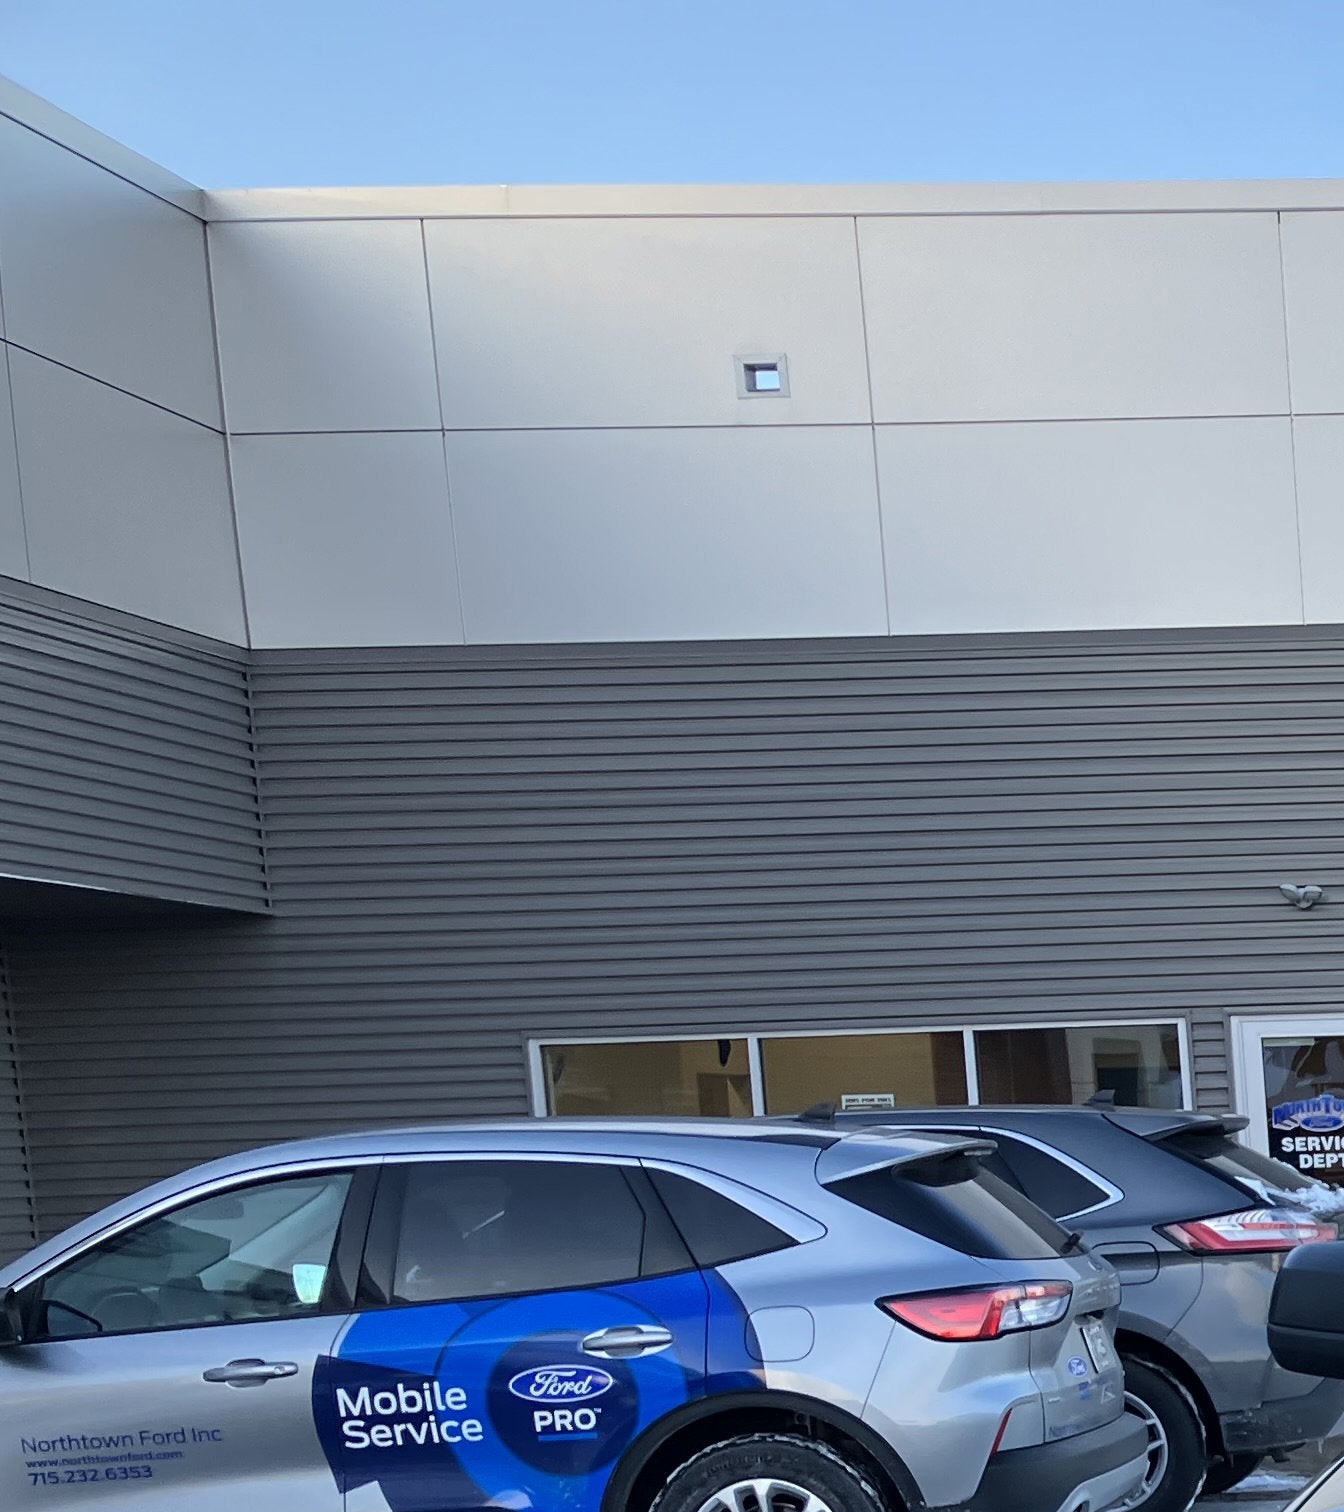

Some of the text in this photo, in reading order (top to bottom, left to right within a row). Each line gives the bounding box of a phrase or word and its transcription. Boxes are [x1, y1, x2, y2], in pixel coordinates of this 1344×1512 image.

[336, 1380, 467, 1417] Mobile
[21, 1427, 223, 1453] Northtown Ford Inc
[342, 1415, 483, 1449] Service
[25, 1450, 184, 1468] www.northtownford.com
[28, 1464, 153, 1486] 715.232.6353
